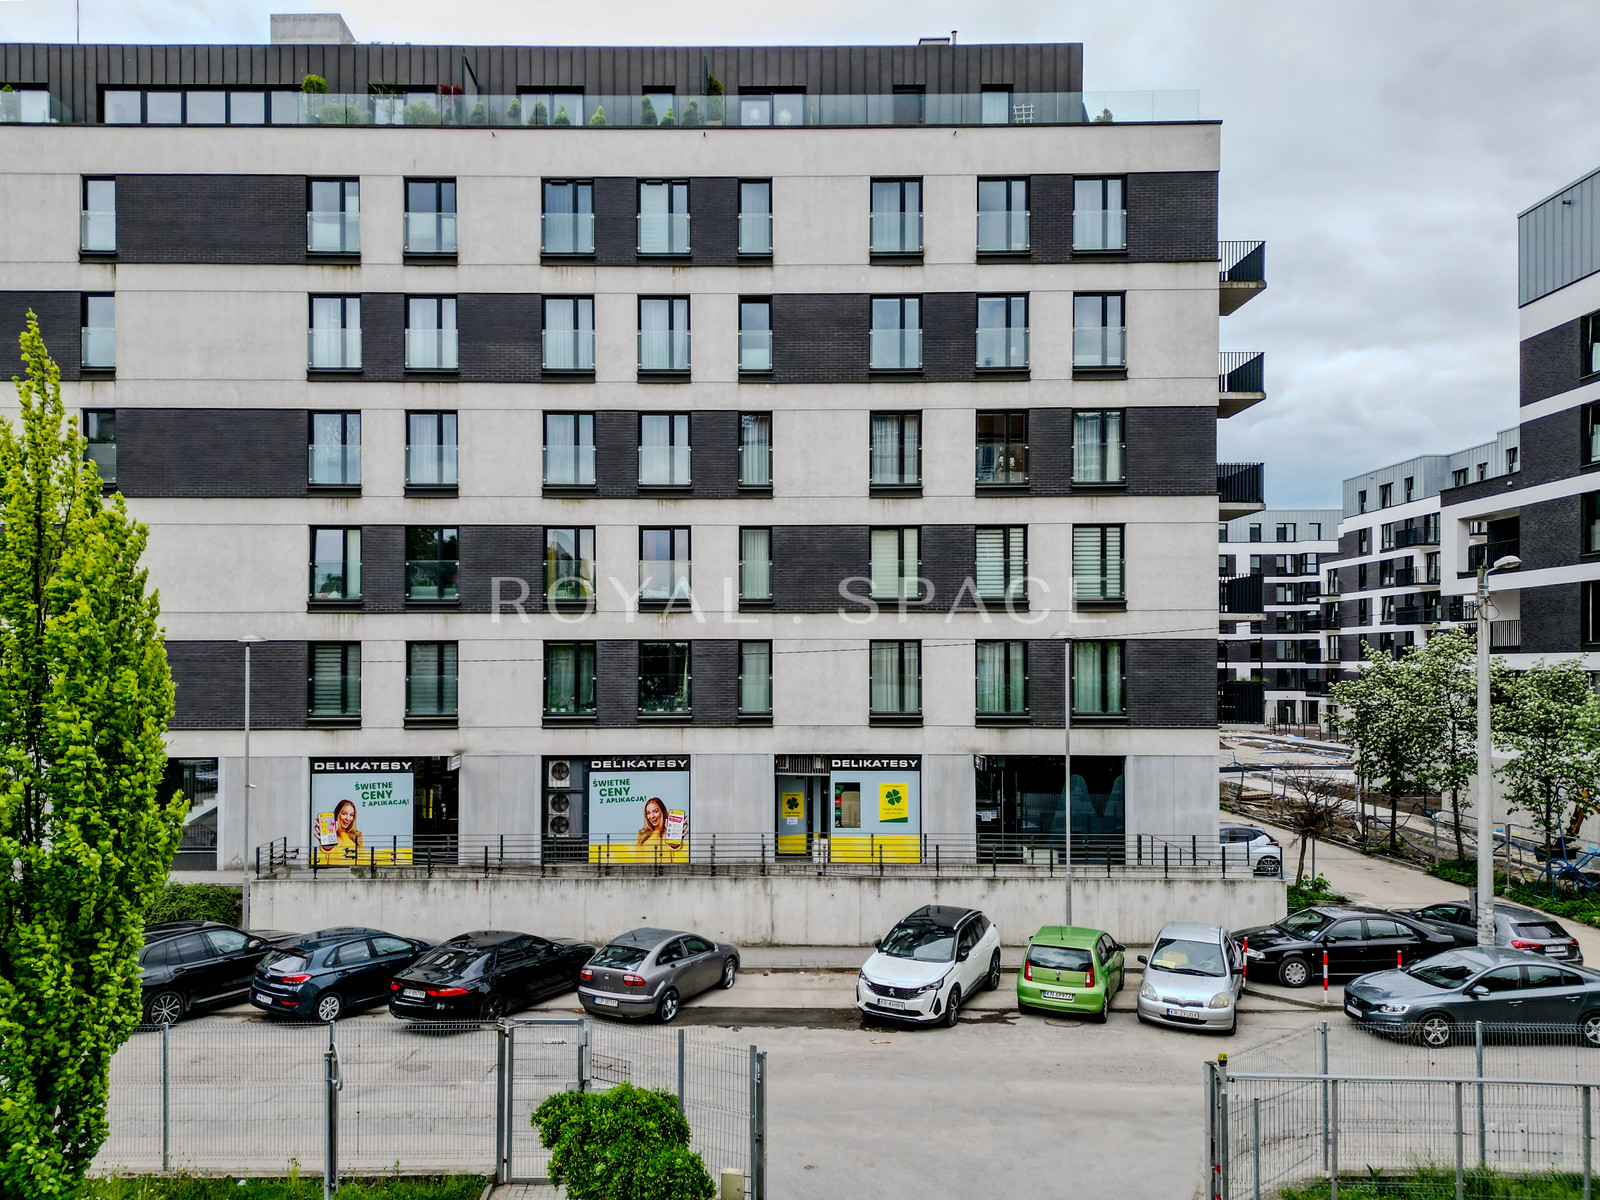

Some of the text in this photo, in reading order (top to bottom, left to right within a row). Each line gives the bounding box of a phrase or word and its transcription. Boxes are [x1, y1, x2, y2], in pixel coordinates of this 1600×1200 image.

[313, 761, 412, 770] DELIKATESY
[591, 759, 687, 769] DELIKATESY
[831, 759, 918, 768] DELIKATESY
[354, 781, 393, 790] ŚWIETNE
[592, 778, 631, 787] ŚWIETNE
[361, 790, 393, 800] CENY
[599, 787, 631, 797] CENY
[368, 799, 410, 807] APLIKACJĄ!
[606, 796, 647, 804] APLIKACJĄ!
